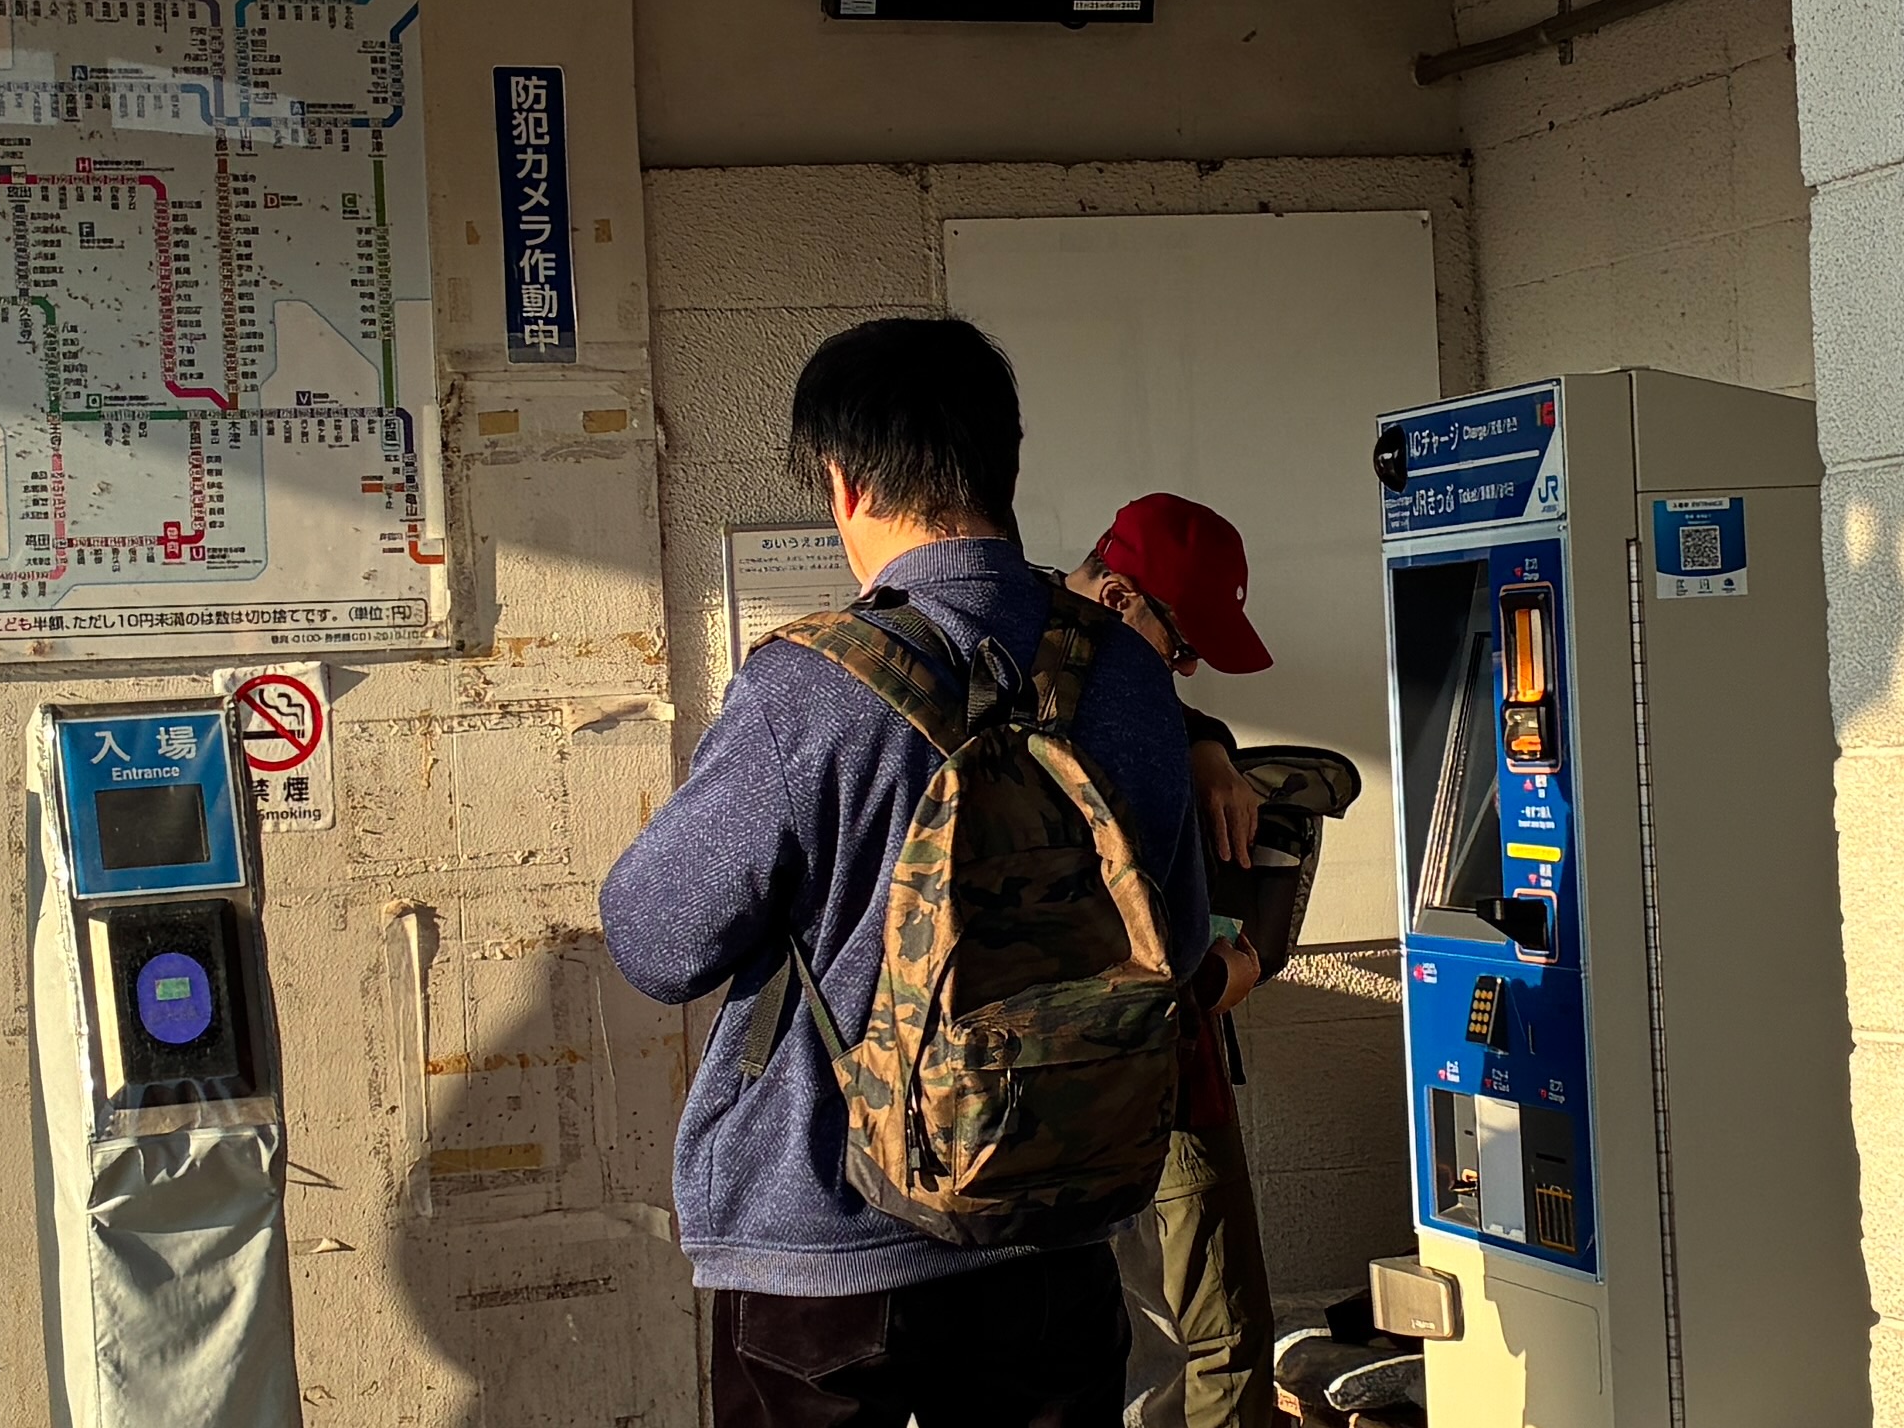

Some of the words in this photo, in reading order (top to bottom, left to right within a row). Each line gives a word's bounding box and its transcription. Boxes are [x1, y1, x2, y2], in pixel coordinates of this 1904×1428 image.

[510, 75, 559, 354] 防犯カメラ作動中
[1409, 423, 1460, 458] ICチャージ
[1412, 484, 1455, 517] JRきっぷ
[1538, 475, 1559, 503] JR
[90, 725, 198, 765] 入場
[112, 765, 180, 782] Entrance
